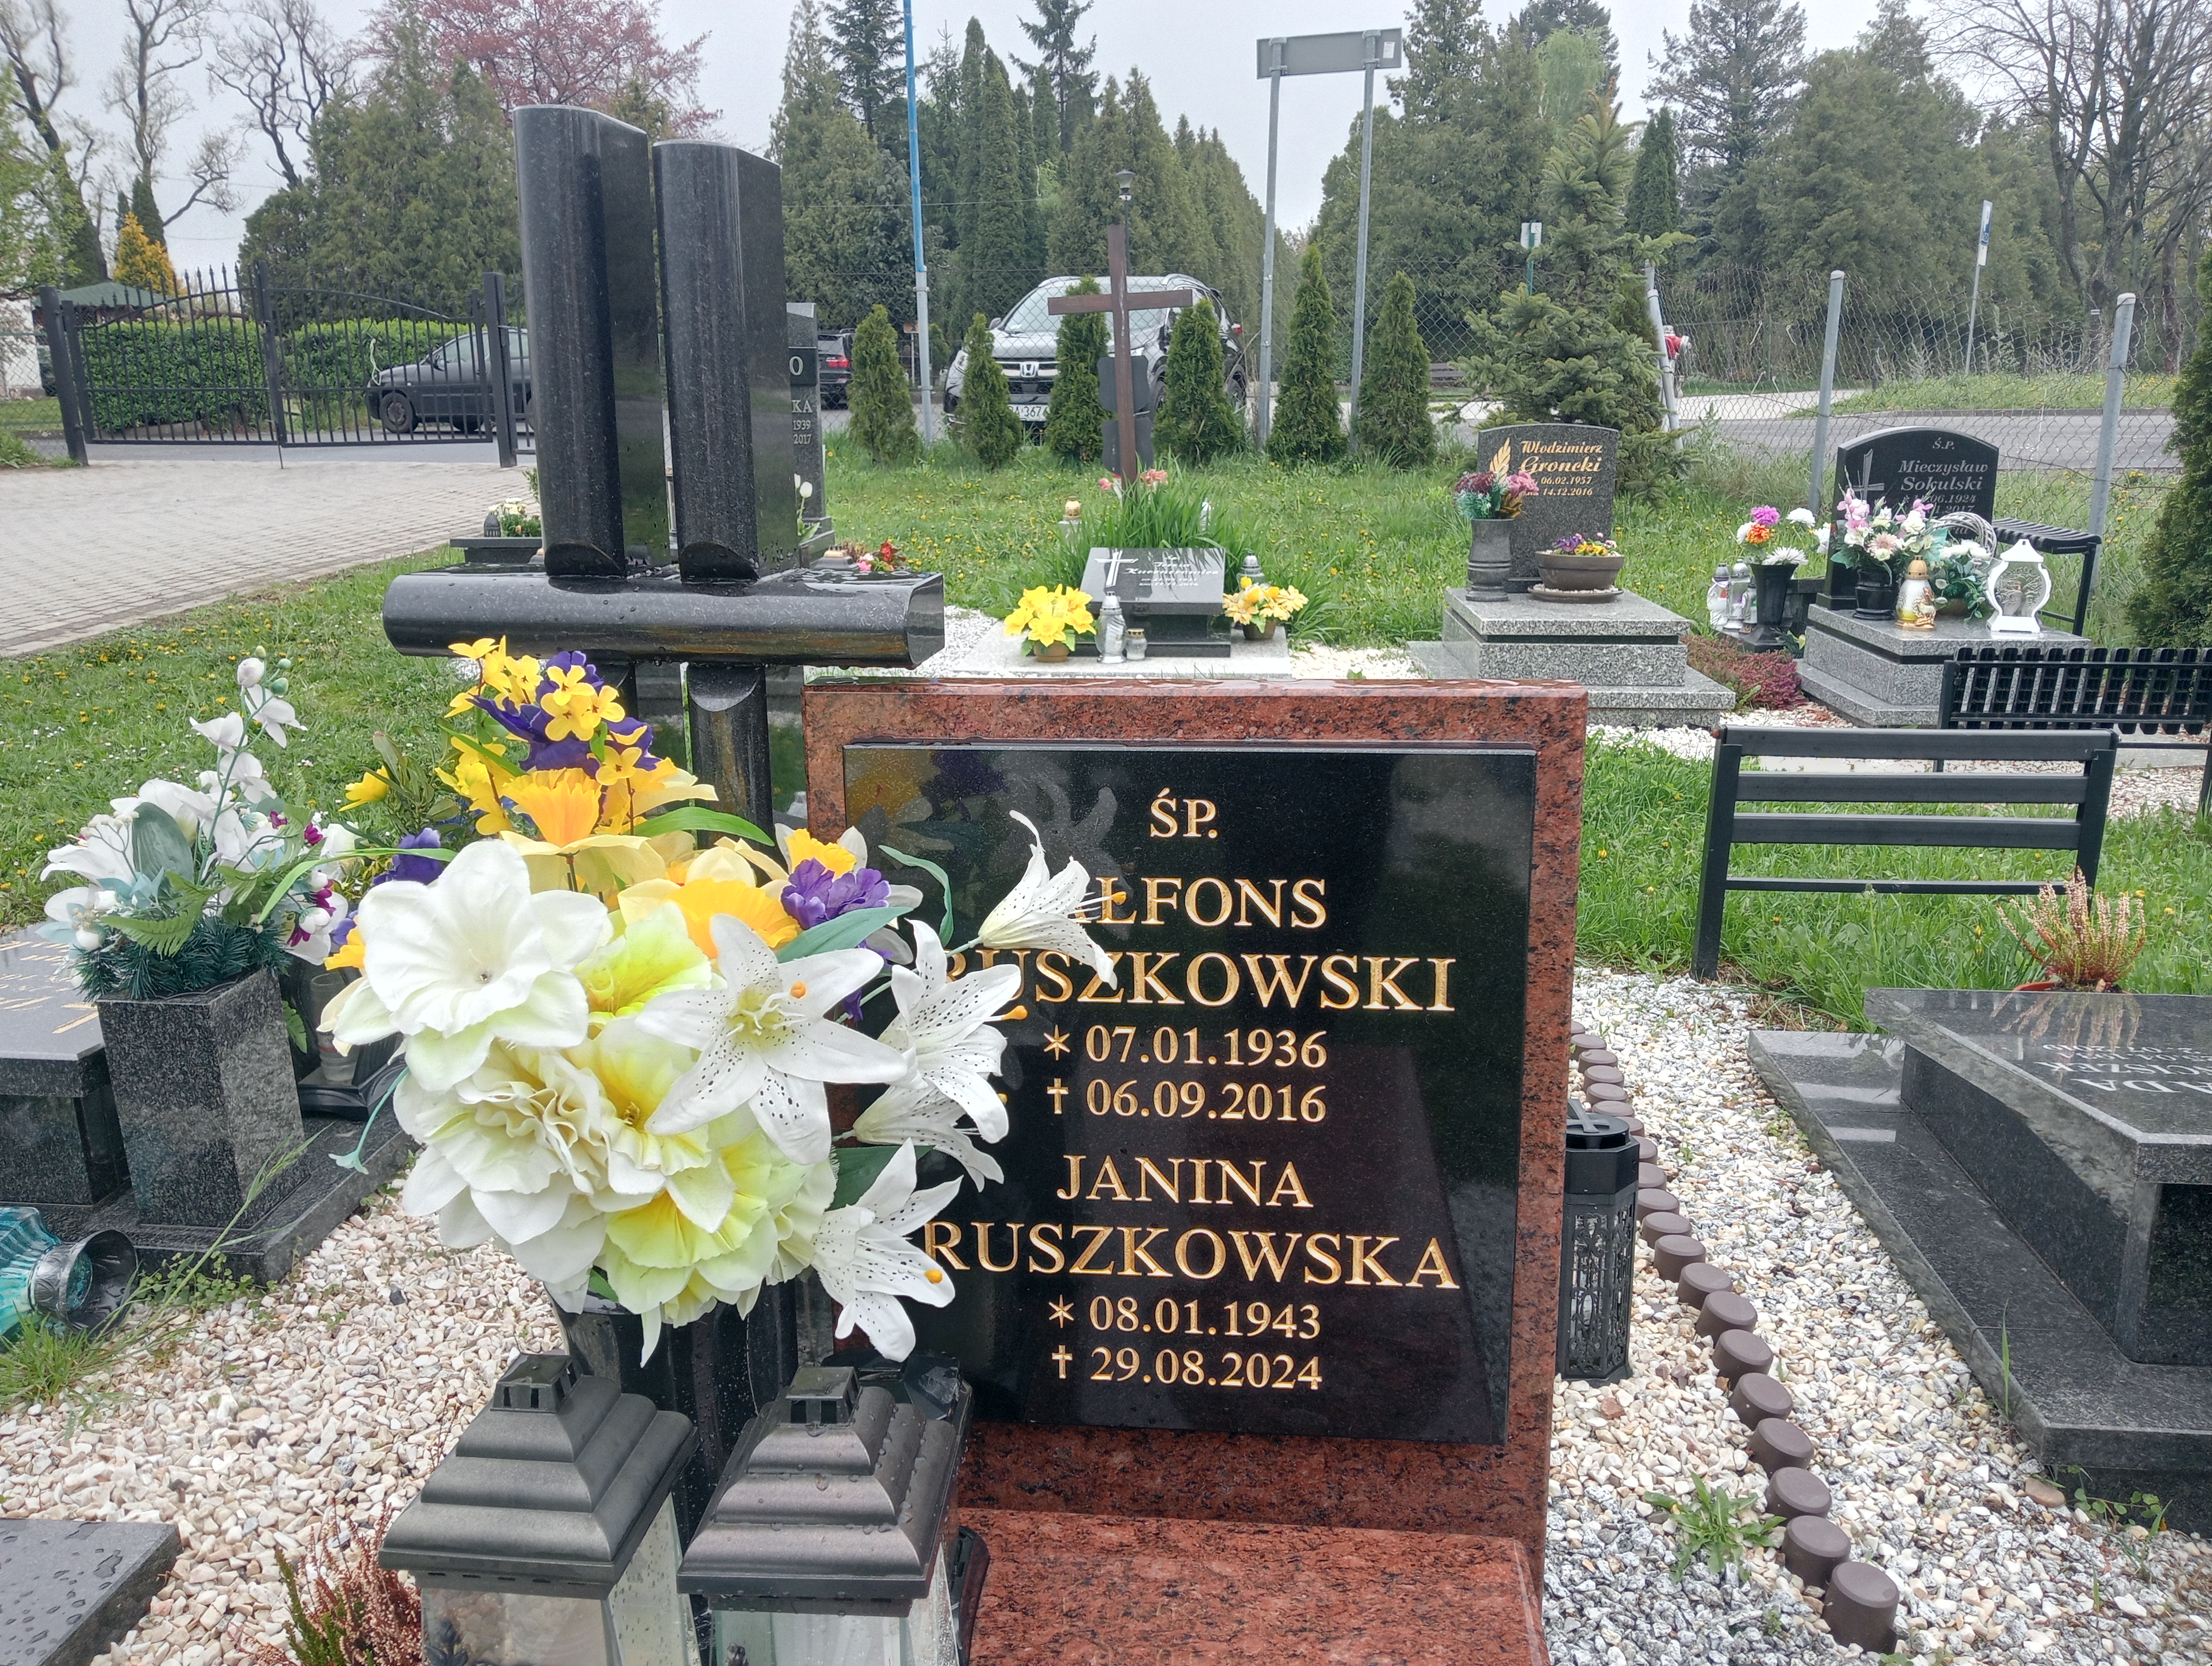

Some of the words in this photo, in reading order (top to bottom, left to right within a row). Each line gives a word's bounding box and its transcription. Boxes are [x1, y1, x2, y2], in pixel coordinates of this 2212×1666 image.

[793, 419, 811, 431] 1939
[793, 434, 812, 445] 2017
[1520, 440, 1604, 454] Włodzimierz
[1932, 437, 1955, 450] Ś.P.
[1898, 459, 1989, 476] Mieczysław
[1540, 476, 1593, 485] 06.02.1957
[1900, 476, 1983, 491] Sokulski
[1542, 488, 1593, 496] 14.12.2016
[1149, 787, 1219, 840] ŚP.
[1085, 1024, 1327, 1069] 07.01.1936
[1086, 1078, 1326, 1123] 06.09.2016
[1057, 1155, 1314, 1208] JANINA
[923, 1221, 1460, 1289] RUSZKOWSKA
[1089, 1295, 1321, 1340] 08.01.1943
[1090, 1346, 1323, 1391] 29.08.2024
